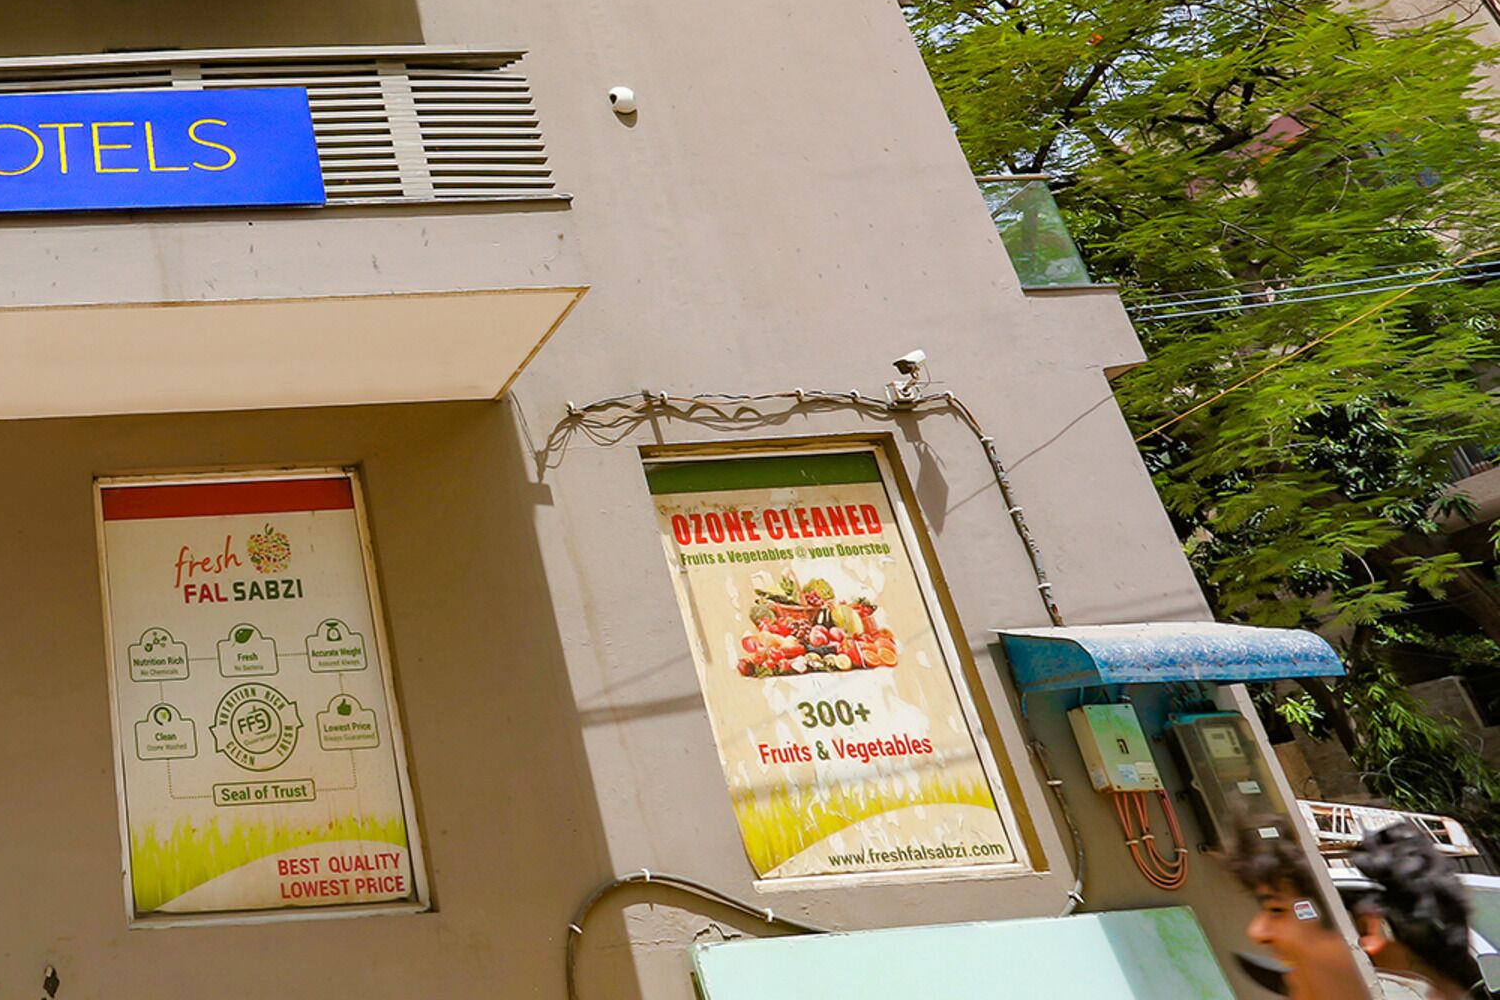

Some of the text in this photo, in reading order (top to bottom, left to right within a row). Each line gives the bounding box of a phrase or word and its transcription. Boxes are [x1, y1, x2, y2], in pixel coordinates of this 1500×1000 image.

[671, 503, 883, 546] OZONE CLEANED
[174, 535, 243, 589] fresh
[680, 551, 716, 567] Fruits
[717, 552, 725, 564] &
[726, 547, 794, 565] Vegetables
[808, 546, 835, 560] your
[836, 542, 892, 558] Doorstep
[184, 578, 303, 604] FAL SABZI
[133, 656, 185, 666] Nutrition Rich
[237, 652, 259, 661] Fresh
[311, 647, 362, 658] Accurate Weight
[219, 687, 287, 726] NUTRITION RICH
[797, 698, 871, 729] 300+
[237, 712, 267, 735] FFS
[323, 721, 372, 733] Lowest Price
[155, 732, 178, 741] Clean
[225, 724, 294, 767] CLEAN FRESH
[758, 734, 934, 766] Fruits & Vegetables
[221, 783, 308, 802] Seal of Trust
[277, 853, 402, 877] BEST QUALITY
[827, 840, 1006, 868] www.freshfalsabzi.com
[280, 875, 406, 900] LOWEST PRICE
